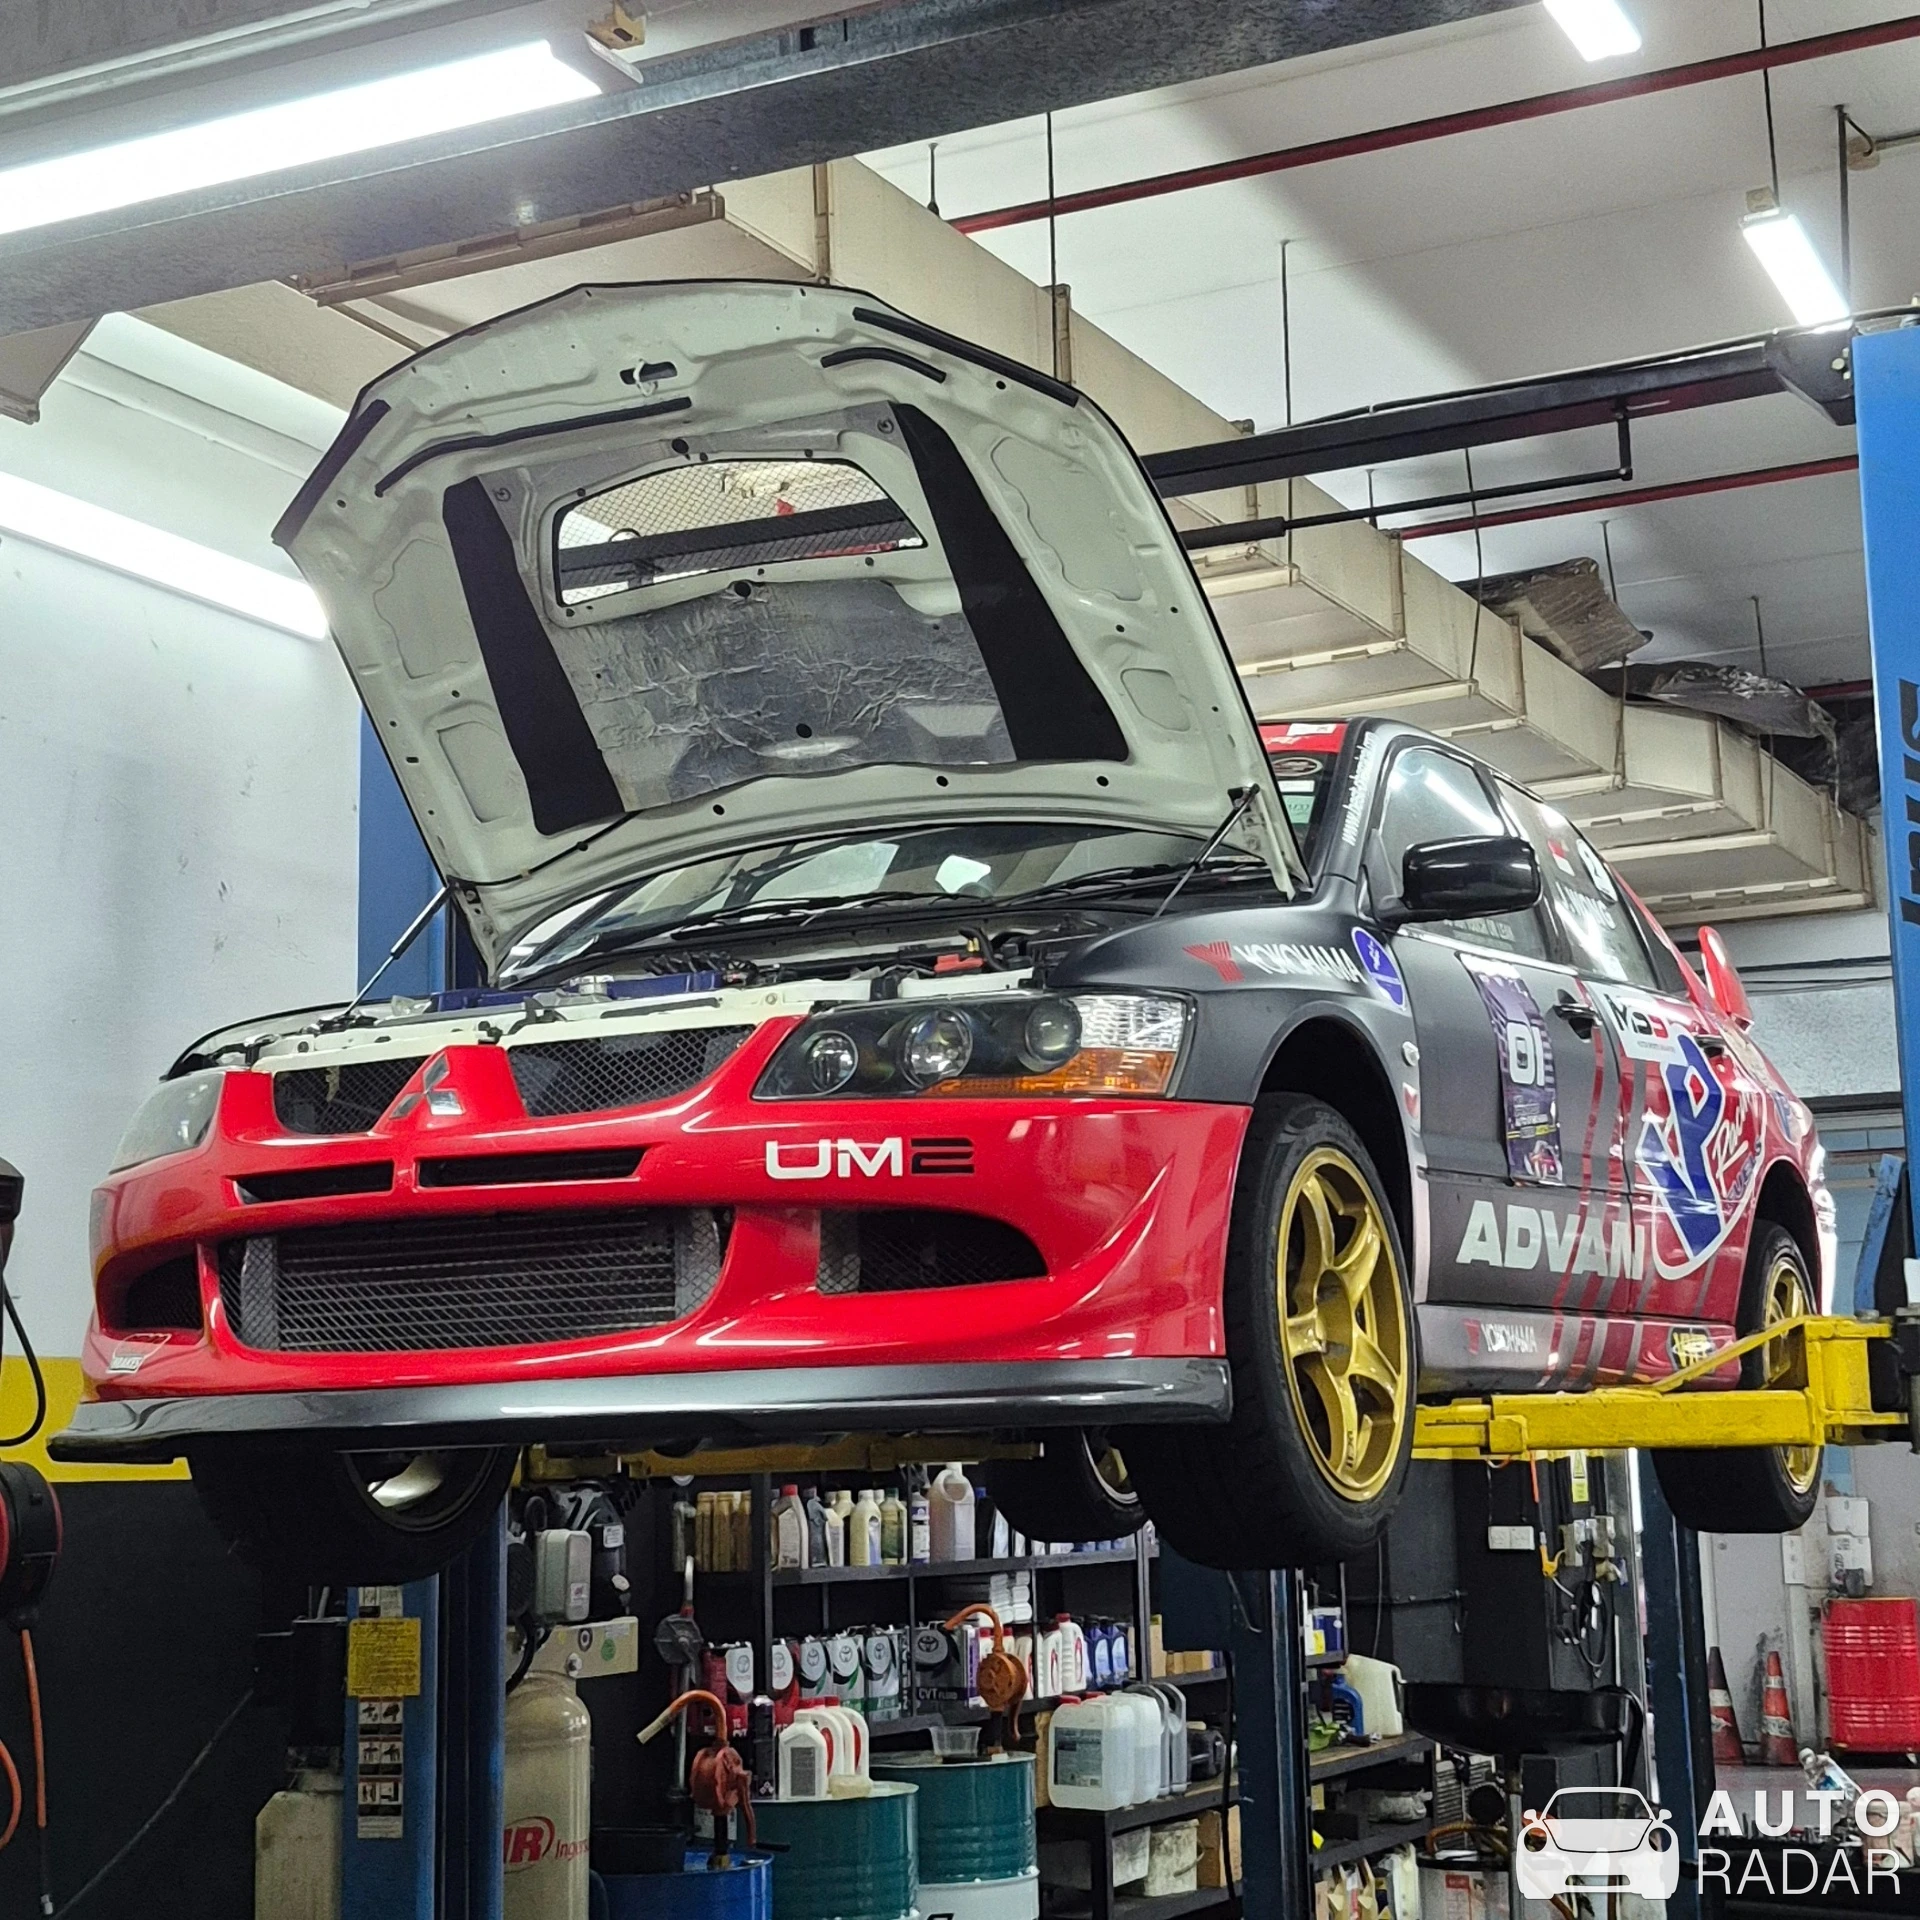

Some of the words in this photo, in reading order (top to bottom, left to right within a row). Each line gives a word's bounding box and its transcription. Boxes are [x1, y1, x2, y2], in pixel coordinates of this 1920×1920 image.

[1233, 943, 1368, 984] YOKOHAMA
[766, 1136, 974, 1179] UM2
[1456, 1200, 1645, 1280] ADVAN
[1481, 1323, 1538, 1353] YOKOHAMA
[919, 1687, 937, 1700] CVT
